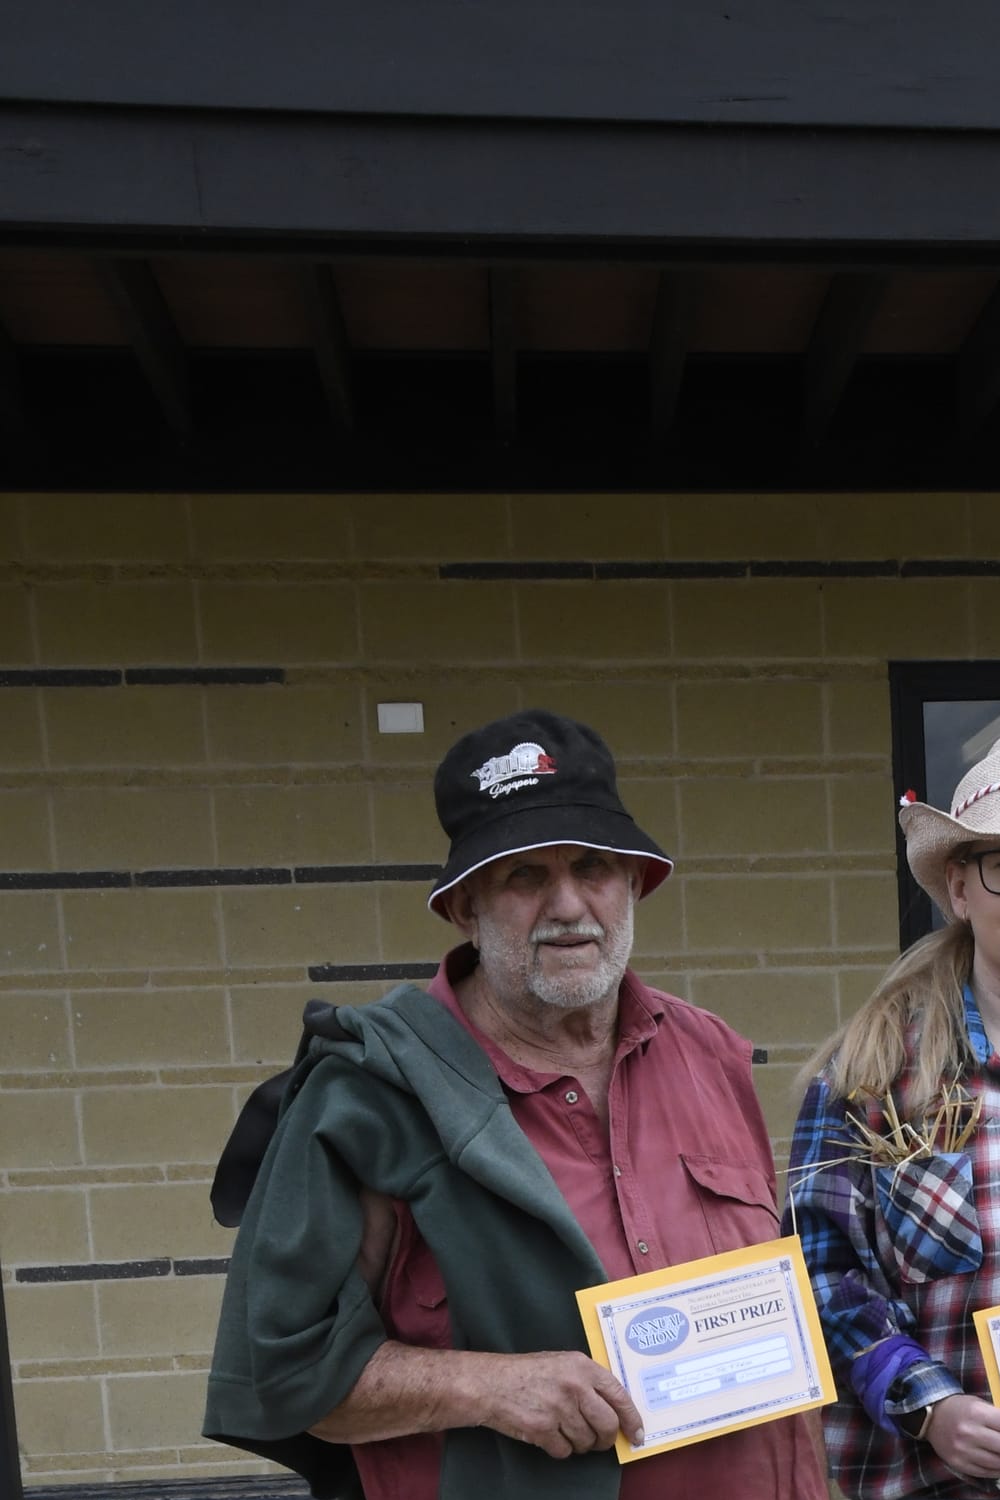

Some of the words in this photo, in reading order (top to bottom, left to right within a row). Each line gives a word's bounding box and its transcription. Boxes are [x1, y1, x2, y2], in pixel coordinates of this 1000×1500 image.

[489, 777, 539, 799] Singapore
[629, 1312, 685, 1339] ANNUAL
[694, 1311, 737, 1333] FIRST
[740, 1298, 786, 1321] PRIZE
[638, 1328, 679, 1349] SHOW
